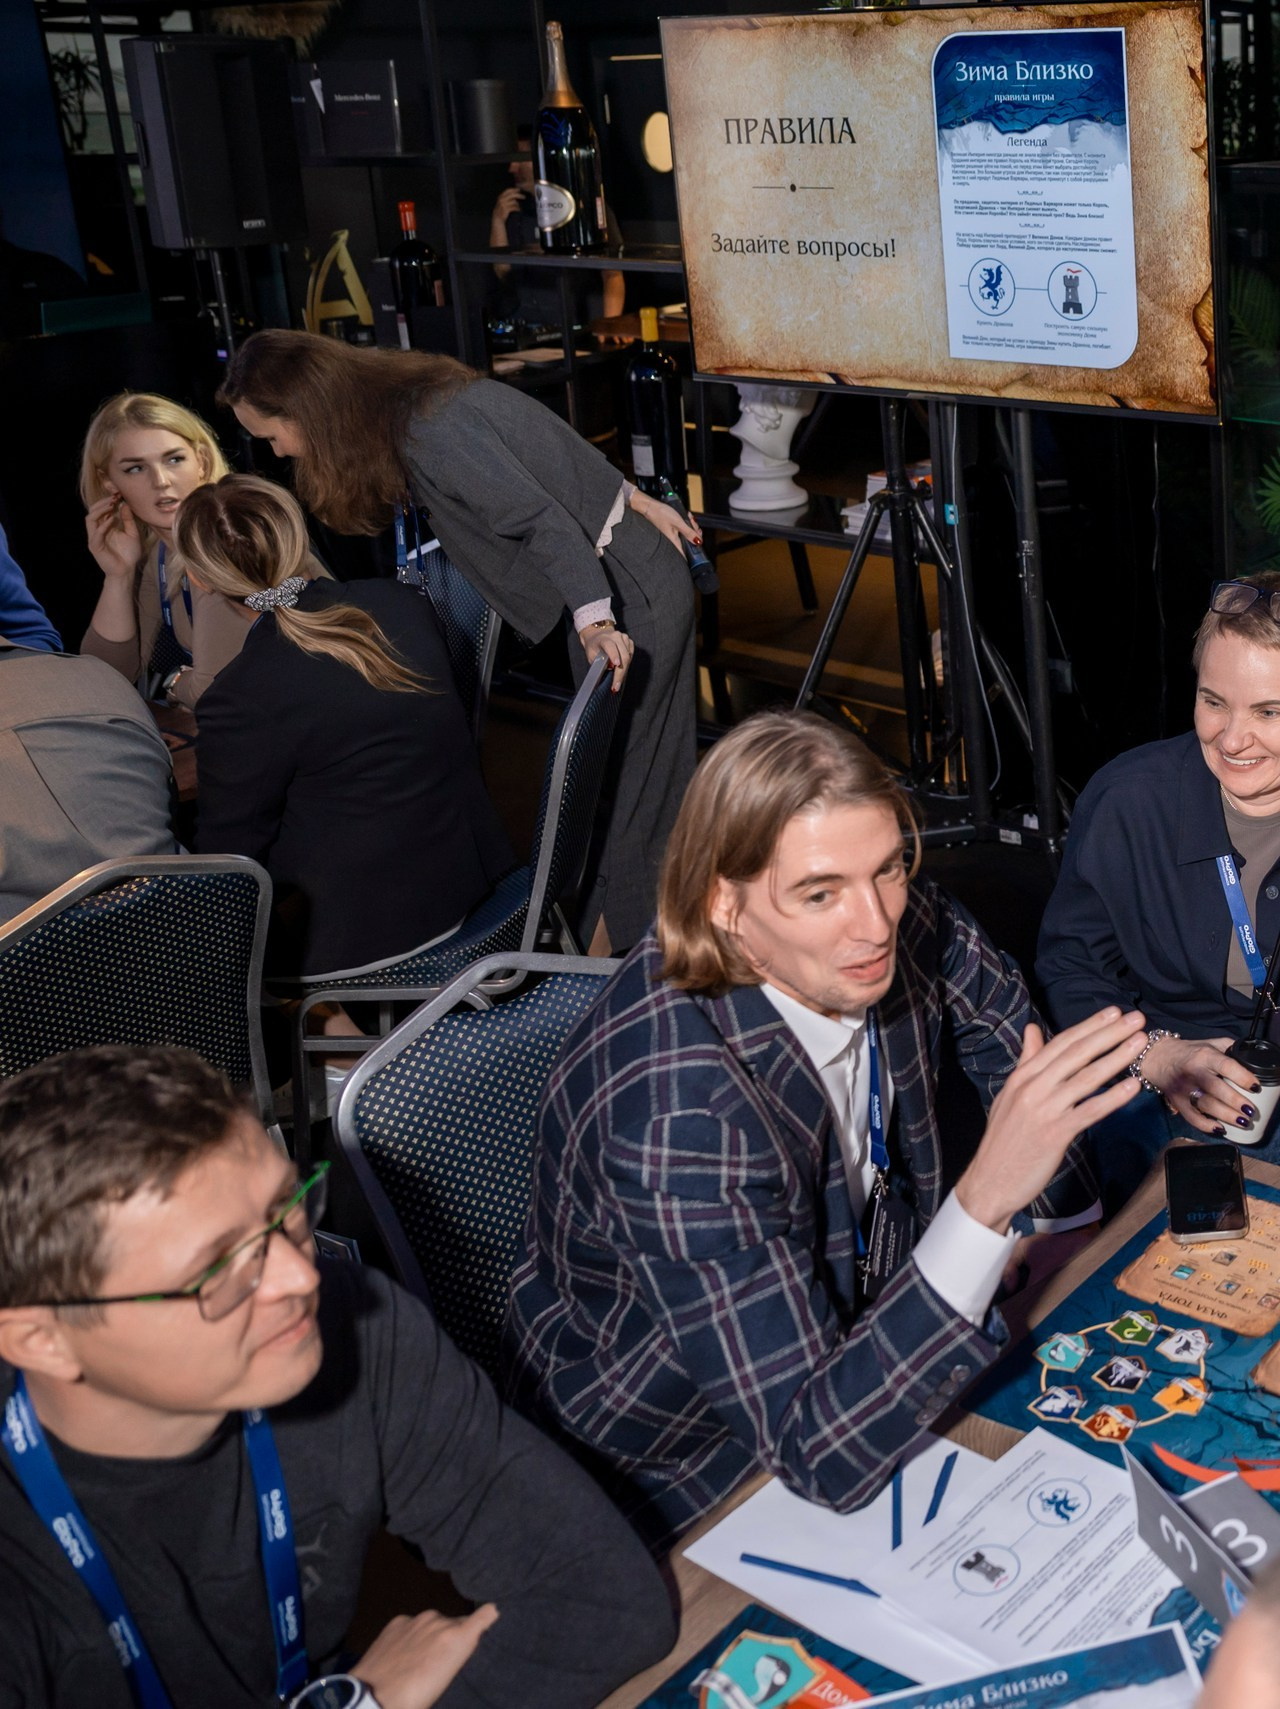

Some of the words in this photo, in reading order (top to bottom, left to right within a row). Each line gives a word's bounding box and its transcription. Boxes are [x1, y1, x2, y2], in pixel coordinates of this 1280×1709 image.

[955, 61, 1008, 82] Зима
[1015, 60, 1094, 82] Близко
[334, 93, 381, 102] Mercedes-Benz
[994, 92, 1030, 104] правила
[1033, 93, 1055, 104] игры
[724, 116, 857, 146] ПРАВИЛА
[1007, 137, 1048, 147] Легенда
[711, 232, 790, 257] Задайте
[797, 238, 896, 263] вопросы!
[1224, 855, 1236, 885] GloPro
[1243, 924, 1256, 954] GloPro
[1158, 1290, 1192, 1312] ТОРГА
[1194, 1303, 1228, 1320] ФАЗА
[1159, 1513, 1198, 1573] 3
[1210, 1518, 1268, 1567] 3
[981, 1669, 1068, 1705] Близко
